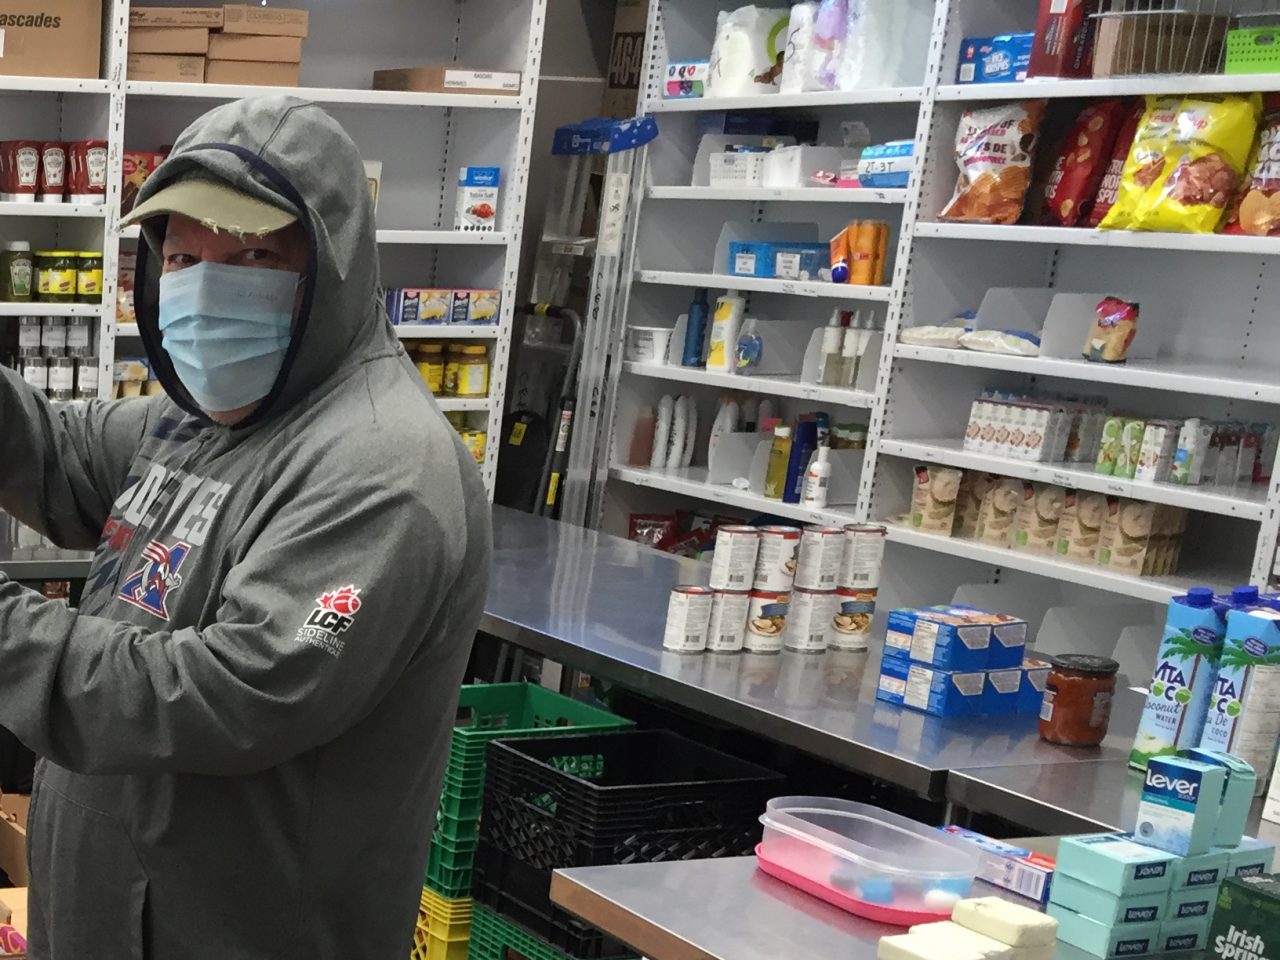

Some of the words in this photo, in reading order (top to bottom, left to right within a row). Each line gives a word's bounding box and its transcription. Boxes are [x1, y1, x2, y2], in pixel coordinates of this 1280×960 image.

[305, 609, 353, 634] LCF
[296, 627, 346, 649] SIDELINE
[1155, 660, 1186, 687] VITA
[1155, 713, 1177, 725] WATER
[1226, 925, 1265, 955] Irish
